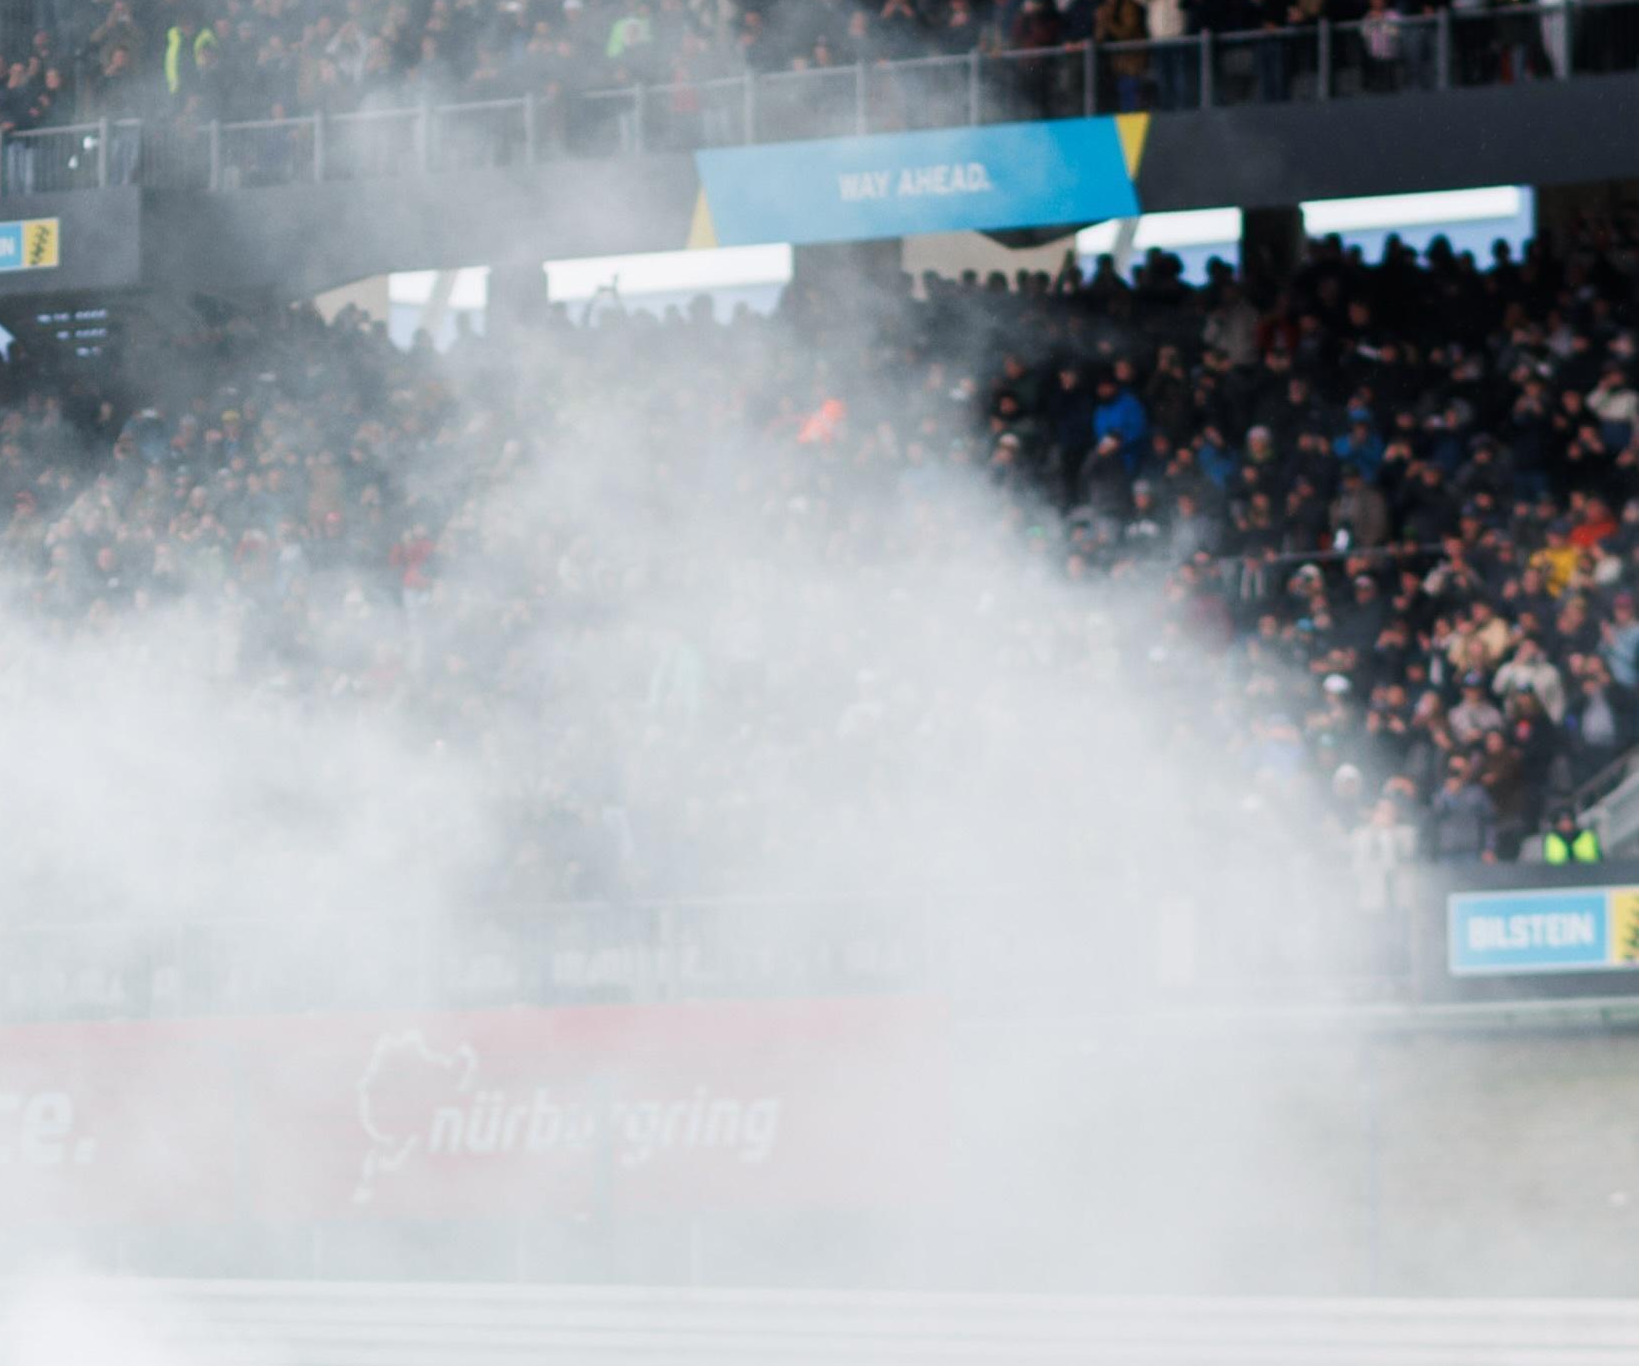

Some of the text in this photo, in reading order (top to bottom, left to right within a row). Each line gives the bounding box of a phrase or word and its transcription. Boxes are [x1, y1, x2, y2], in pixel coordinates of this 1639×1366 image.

[838, 162, 992, 202] WAY AHEAD.
[1466, 911, 1596, 951] BILSTEIN
